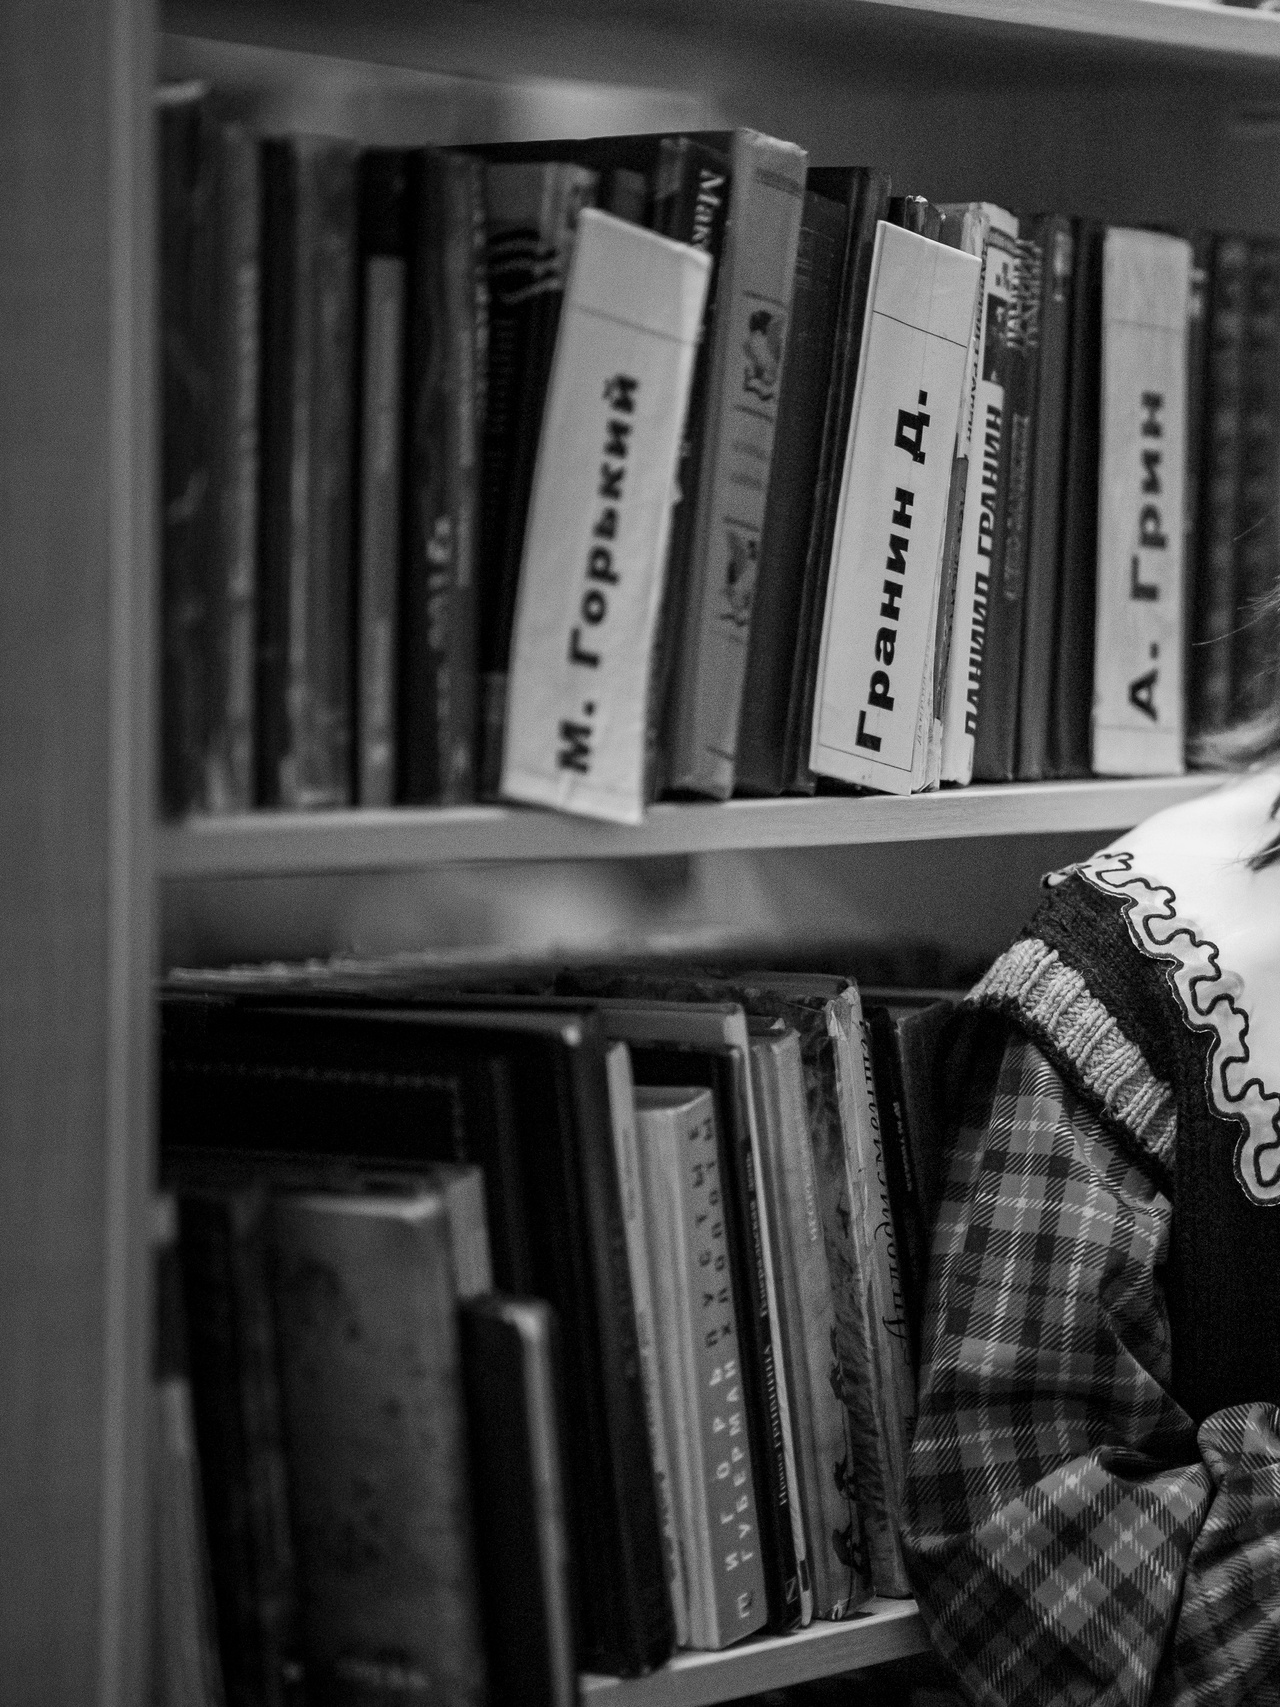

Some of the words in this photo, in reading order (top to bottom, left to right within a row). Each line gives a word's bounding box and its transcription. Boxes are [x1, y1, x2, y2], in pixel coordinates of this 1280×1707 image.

[568, 371, 641, 669] Горький
[855, 486, 915, 752] Гранин
[895, 389, 929, 466] Д.
[977, 403, 1003, 557] ГРАНИН
[1130, 391, 1168, 602] Грин
[556, 698, 593, 774] М.
[1127, 641, 1159, 723] А.
[688, 1126, 719, 1348] ПУСТЫЕ
[708, 1366, 739, 1572] ИГОРЬ
[724, 1359, 754, 1563] ГУБЕРМАН
